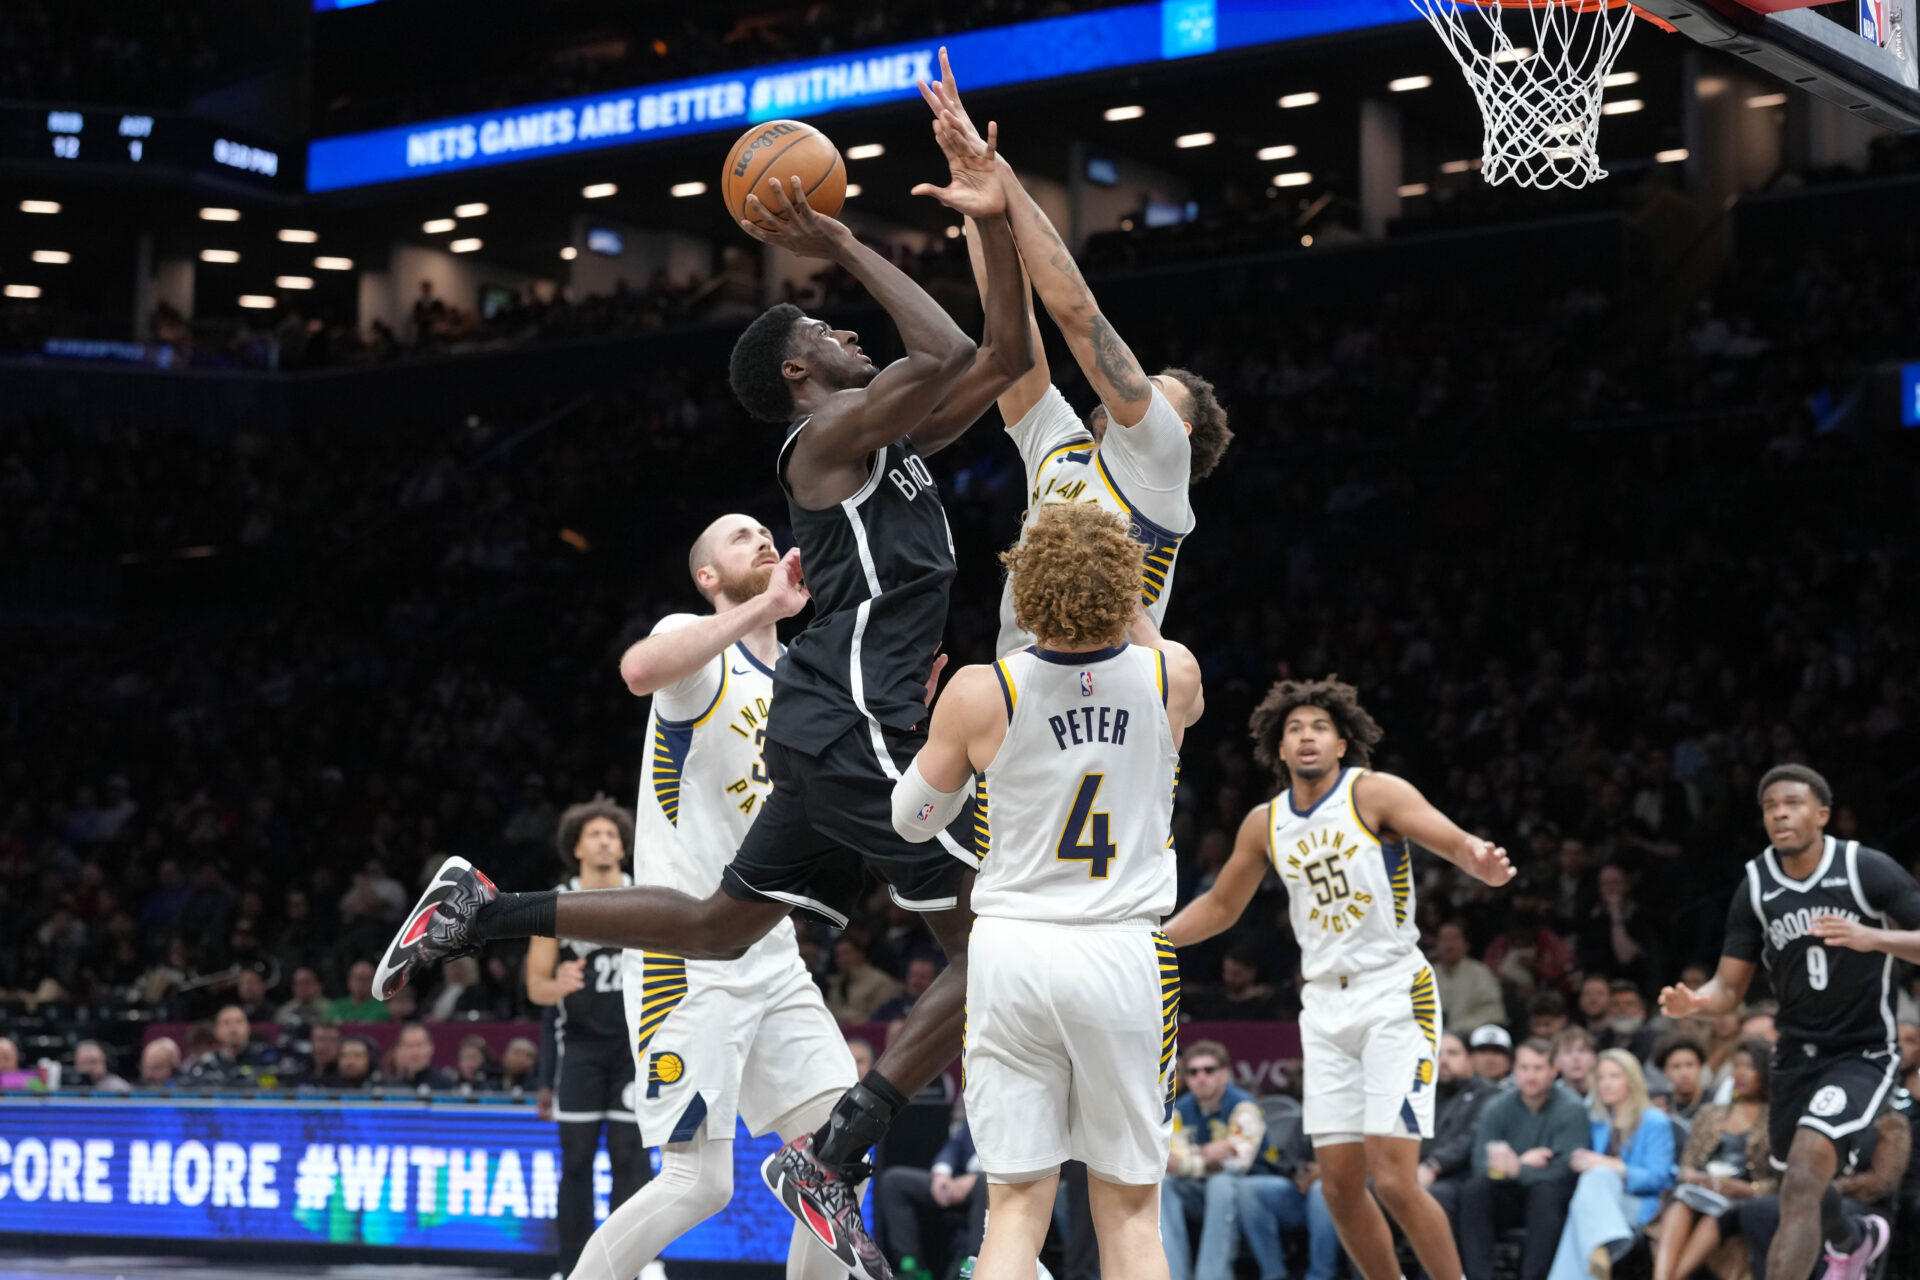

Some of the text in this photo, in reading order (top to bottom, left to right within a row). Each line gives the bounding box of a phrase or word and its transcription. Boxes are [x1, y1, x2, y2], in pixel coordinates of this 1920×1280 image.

[407, 50, 933, 168] NETS GAMES ARE BETTER #WITHAMEX
[734, 123, 804, 177] Wilson
[1048, 706, 1130, 751] PETER
[1055, 773, 1118, 880] 4
[1286, 828, 1359, 880] INDIANA
[1303, 853, 1351, 907] 55
[594, 953, 623, 993] 22
[1806, 945, 1829, 991] 9
[128, 1139, 282, 1209] MORE
